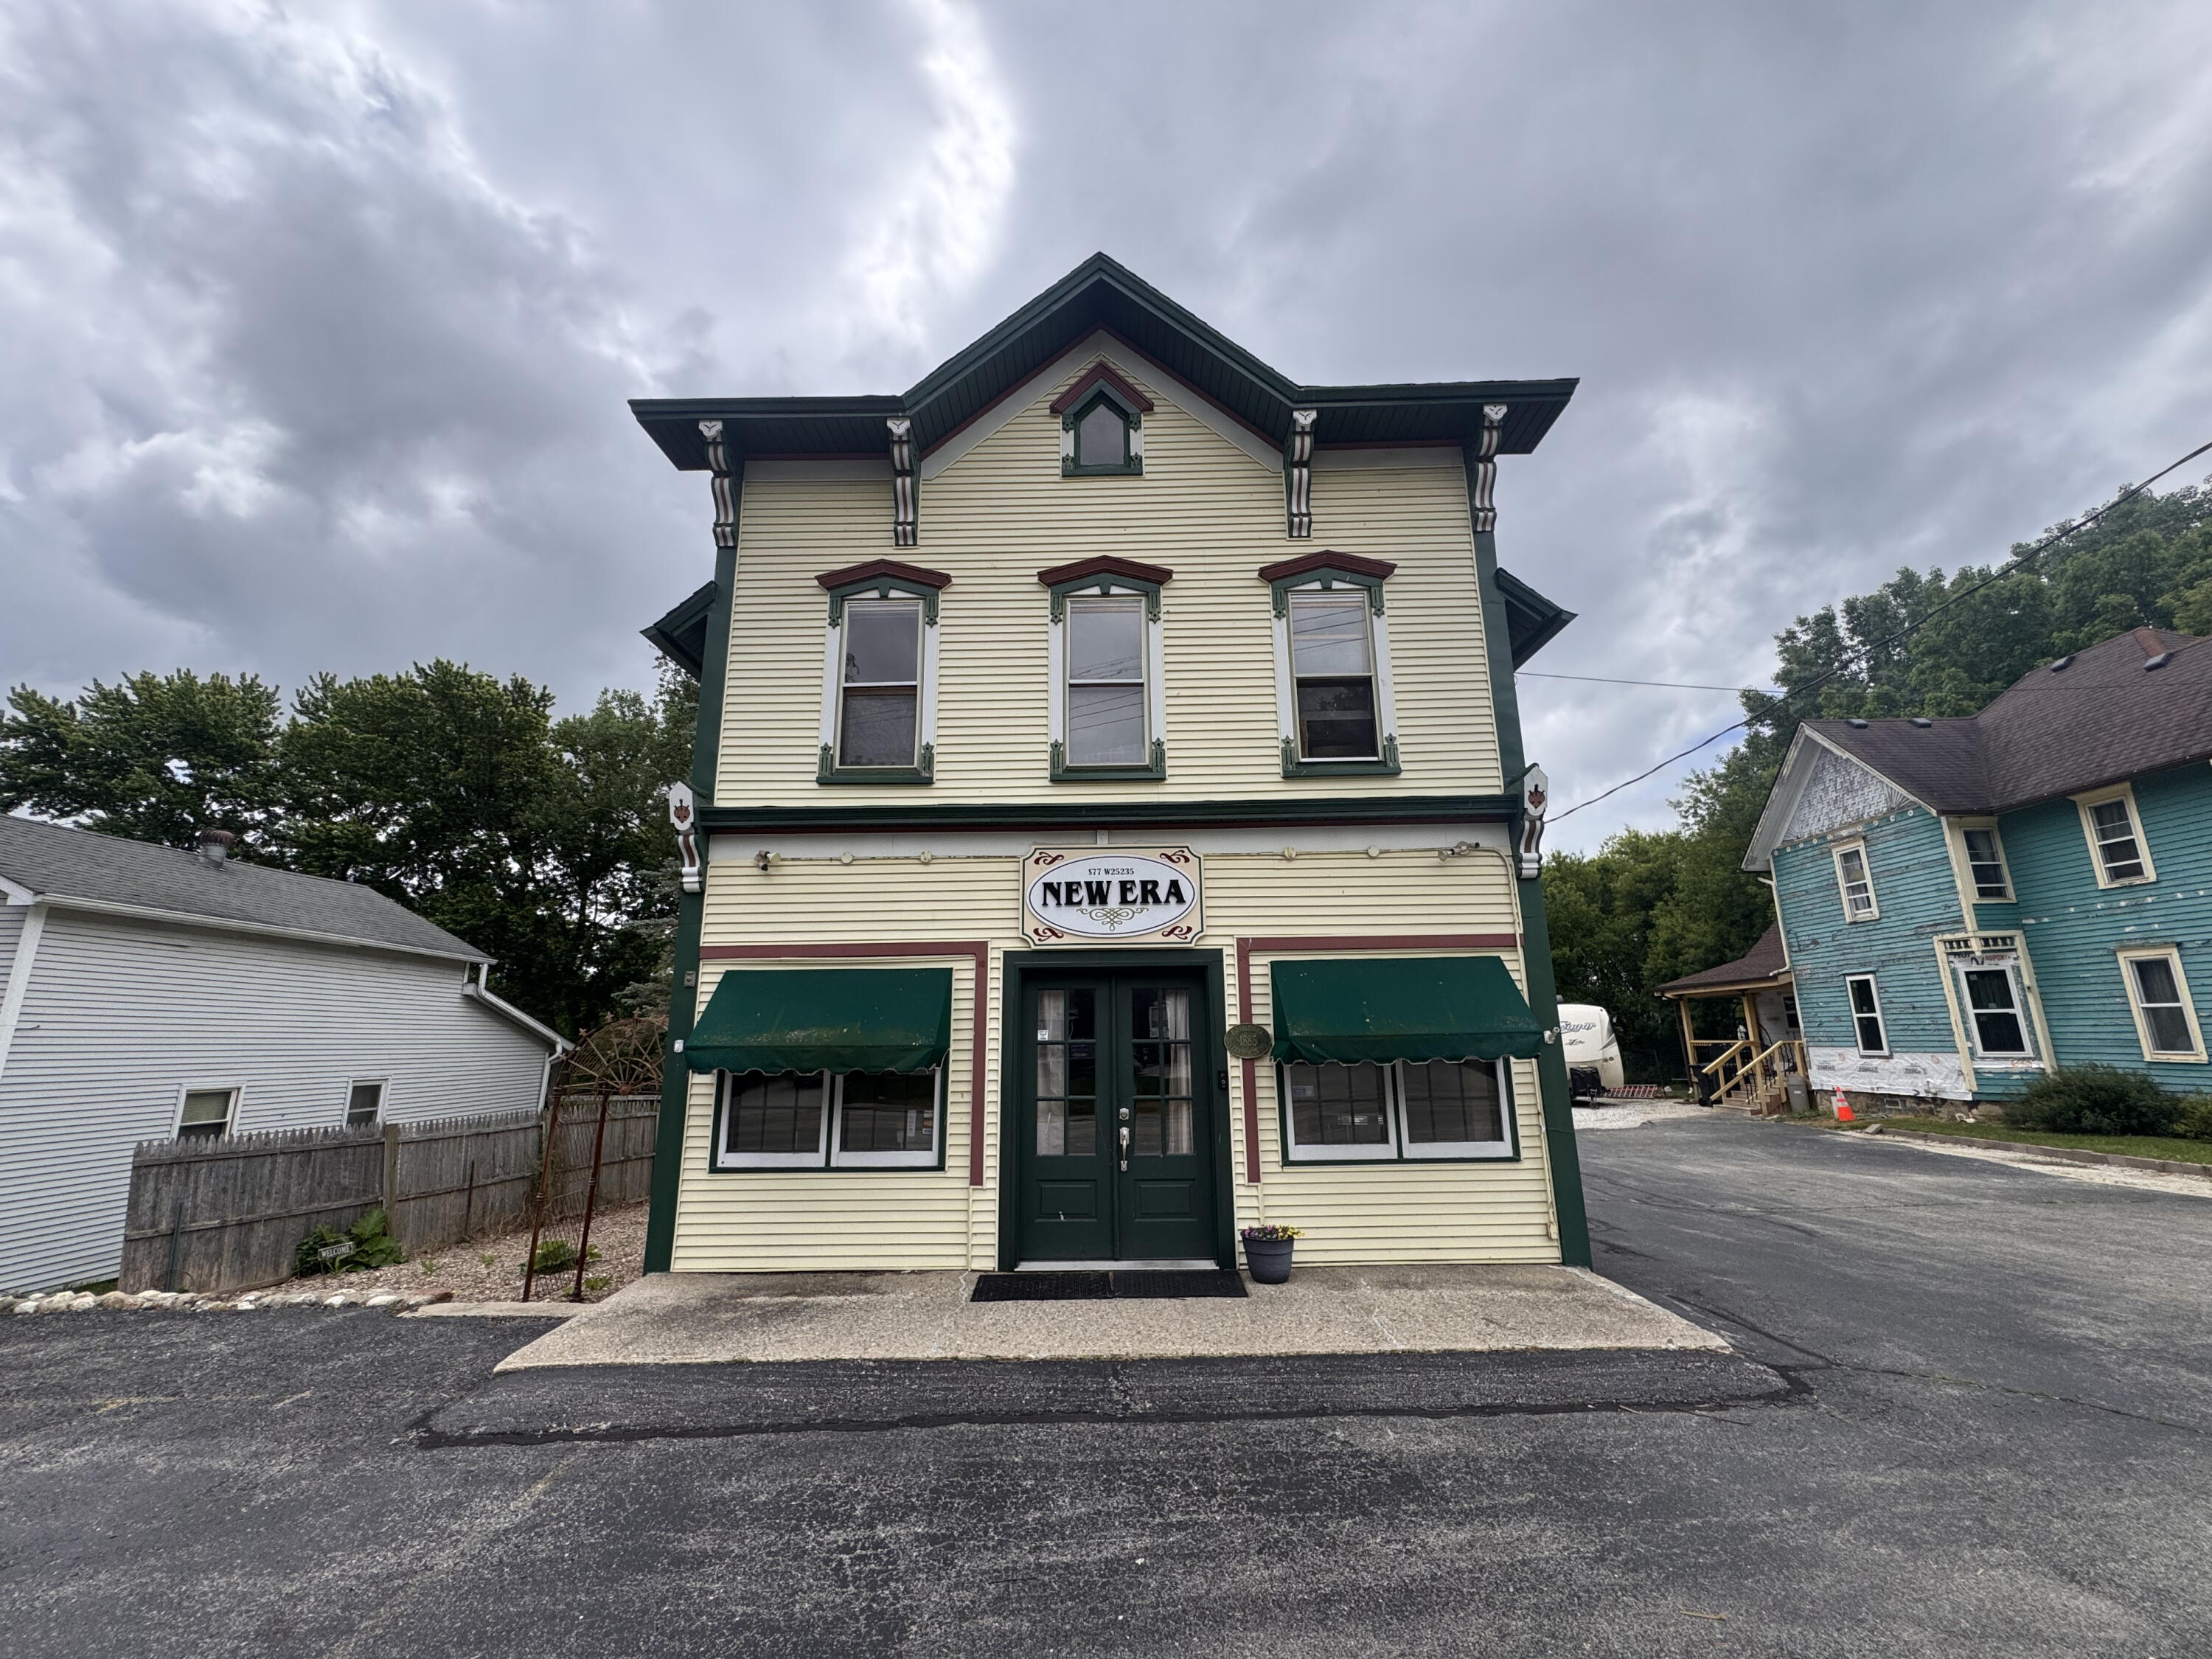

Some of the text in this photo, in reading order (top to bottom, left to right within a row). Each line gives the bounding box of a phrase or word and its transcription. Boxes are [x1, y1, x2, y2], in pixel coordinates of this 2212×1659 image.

[1042, 880, 1186, 905] NEW ERA
[321, 1245, 350, 1258] WELCOME
